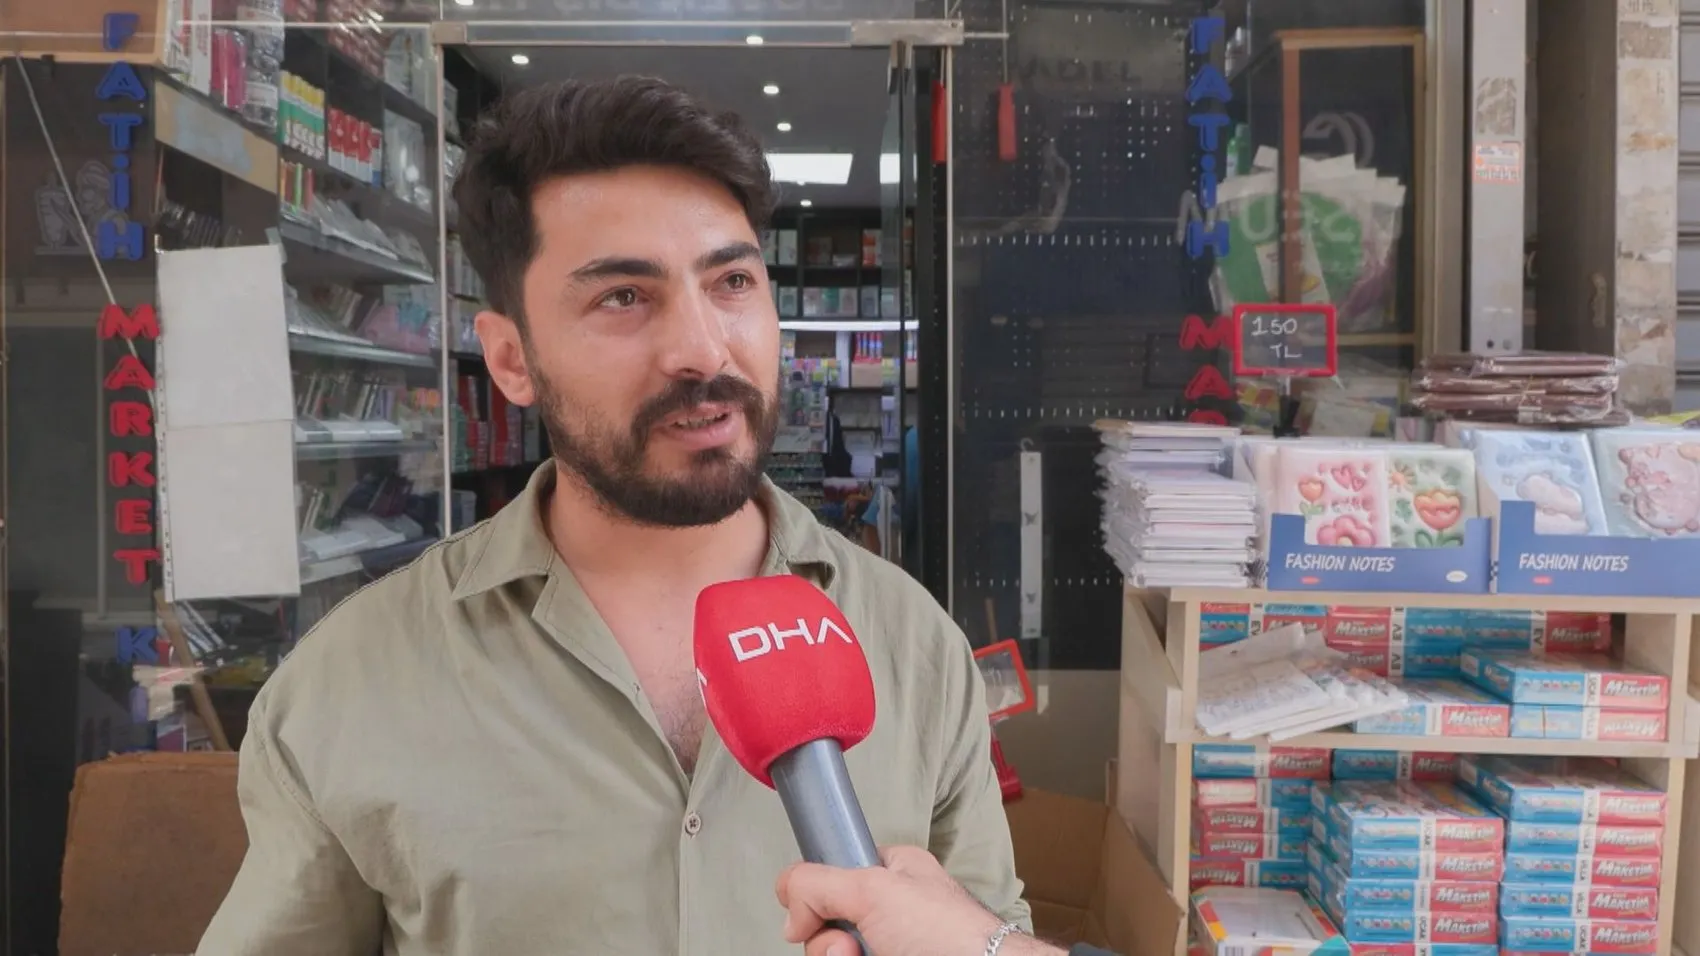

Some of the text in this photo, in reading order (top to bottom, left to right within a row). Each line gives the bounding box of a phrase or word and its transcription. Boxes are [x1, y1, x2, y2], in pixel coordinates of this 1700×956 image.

[1251, 316, 1298, 336] 150
[1269, 342, 1303, 358] TL
[98, 303, 161, 584] MARKET
[1285, 553, 1396, 572] FASHION NOTES
[1519, 553, 1629, 572] FASHION NOTES
[728, 617, 853, 662] DHA
